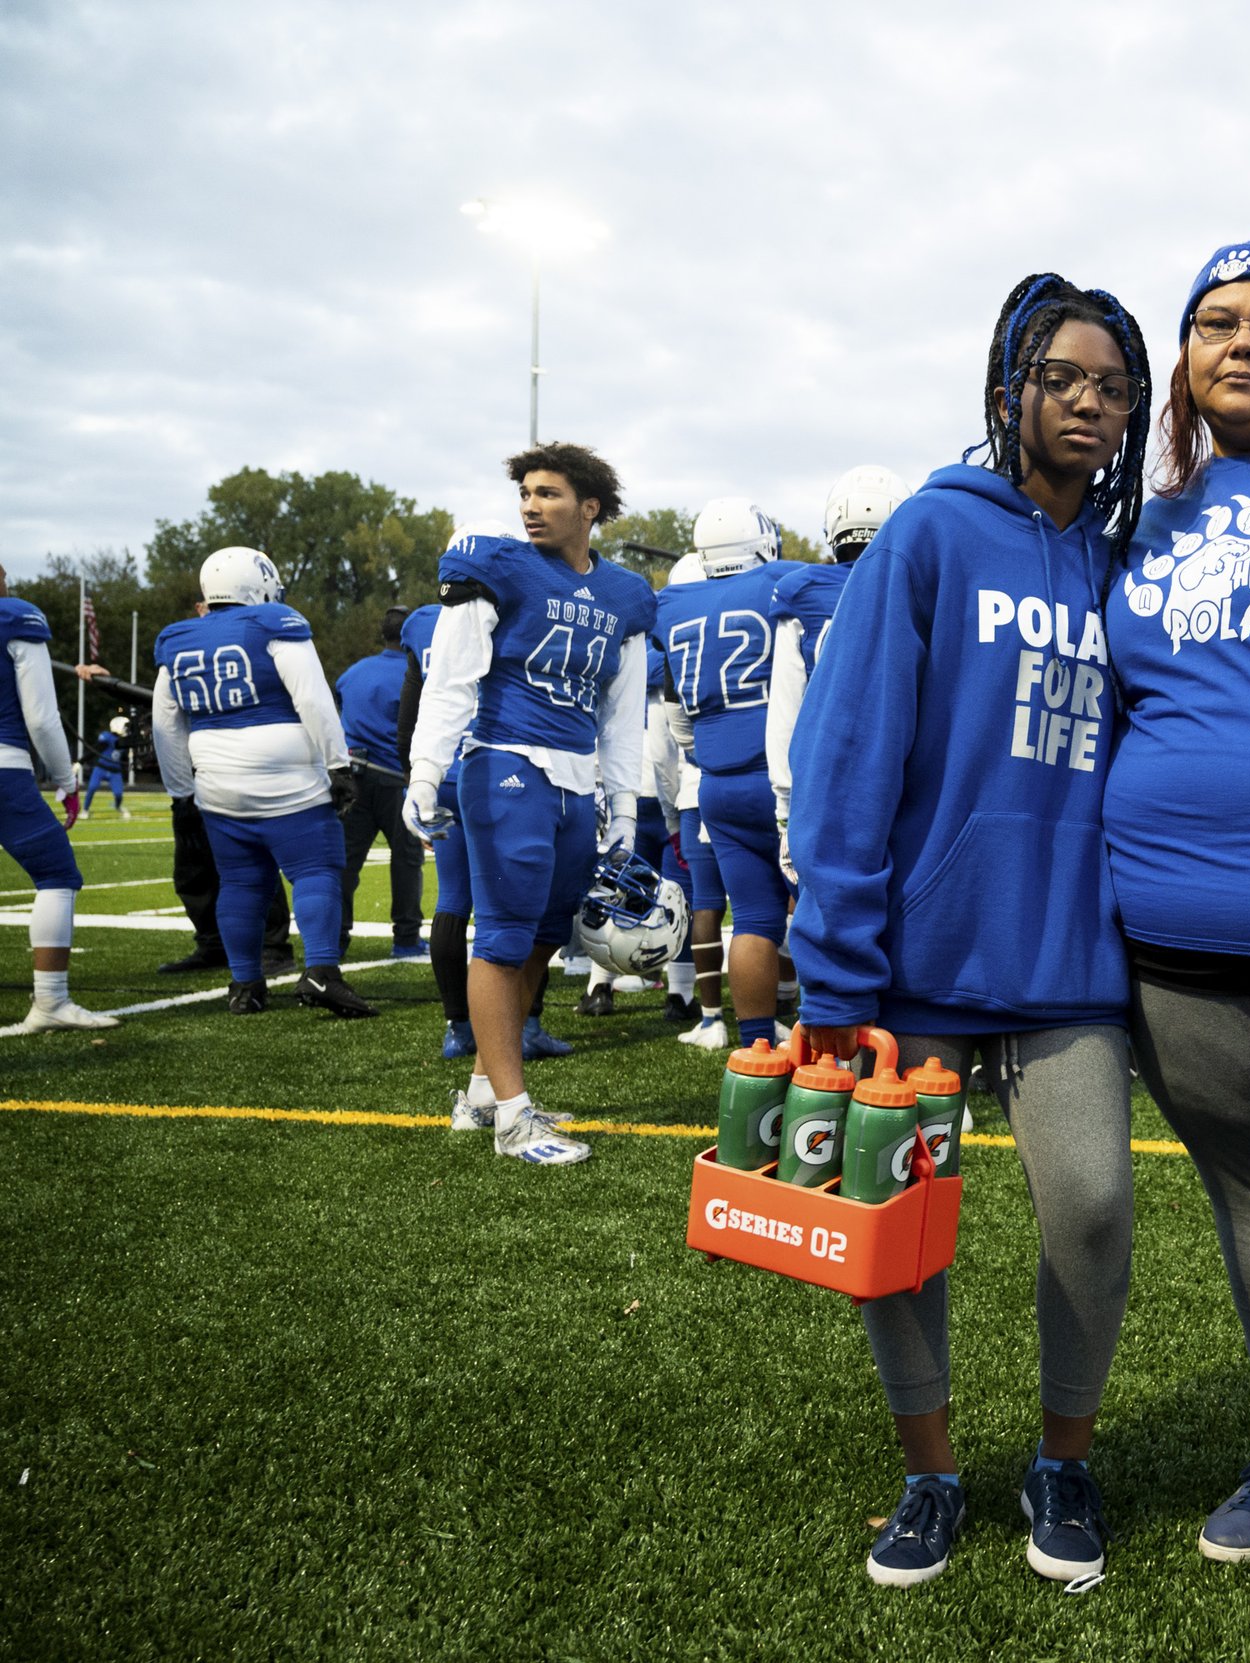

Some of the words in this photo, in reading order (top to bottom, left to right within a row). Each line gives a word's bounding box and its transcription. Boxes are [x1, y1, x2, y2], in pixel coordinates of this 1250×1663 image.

[852, 528, 878, 538] schu
[716, 563, 743, 574] schutt
[547, 599, 618, 636] NORTH
[978, 589, 1108, 666] POLA
[172, 644, 260, 714] 68
[524, 624, 608, 713] 41
[669, 609, 772, 717] 72
[1015, 649, 1104, 719] FOR
[1011, 705, 1100, 772] LIFE
[794, 1119, 837, 1166] G
[810, 1226, 848, 1264] 02
